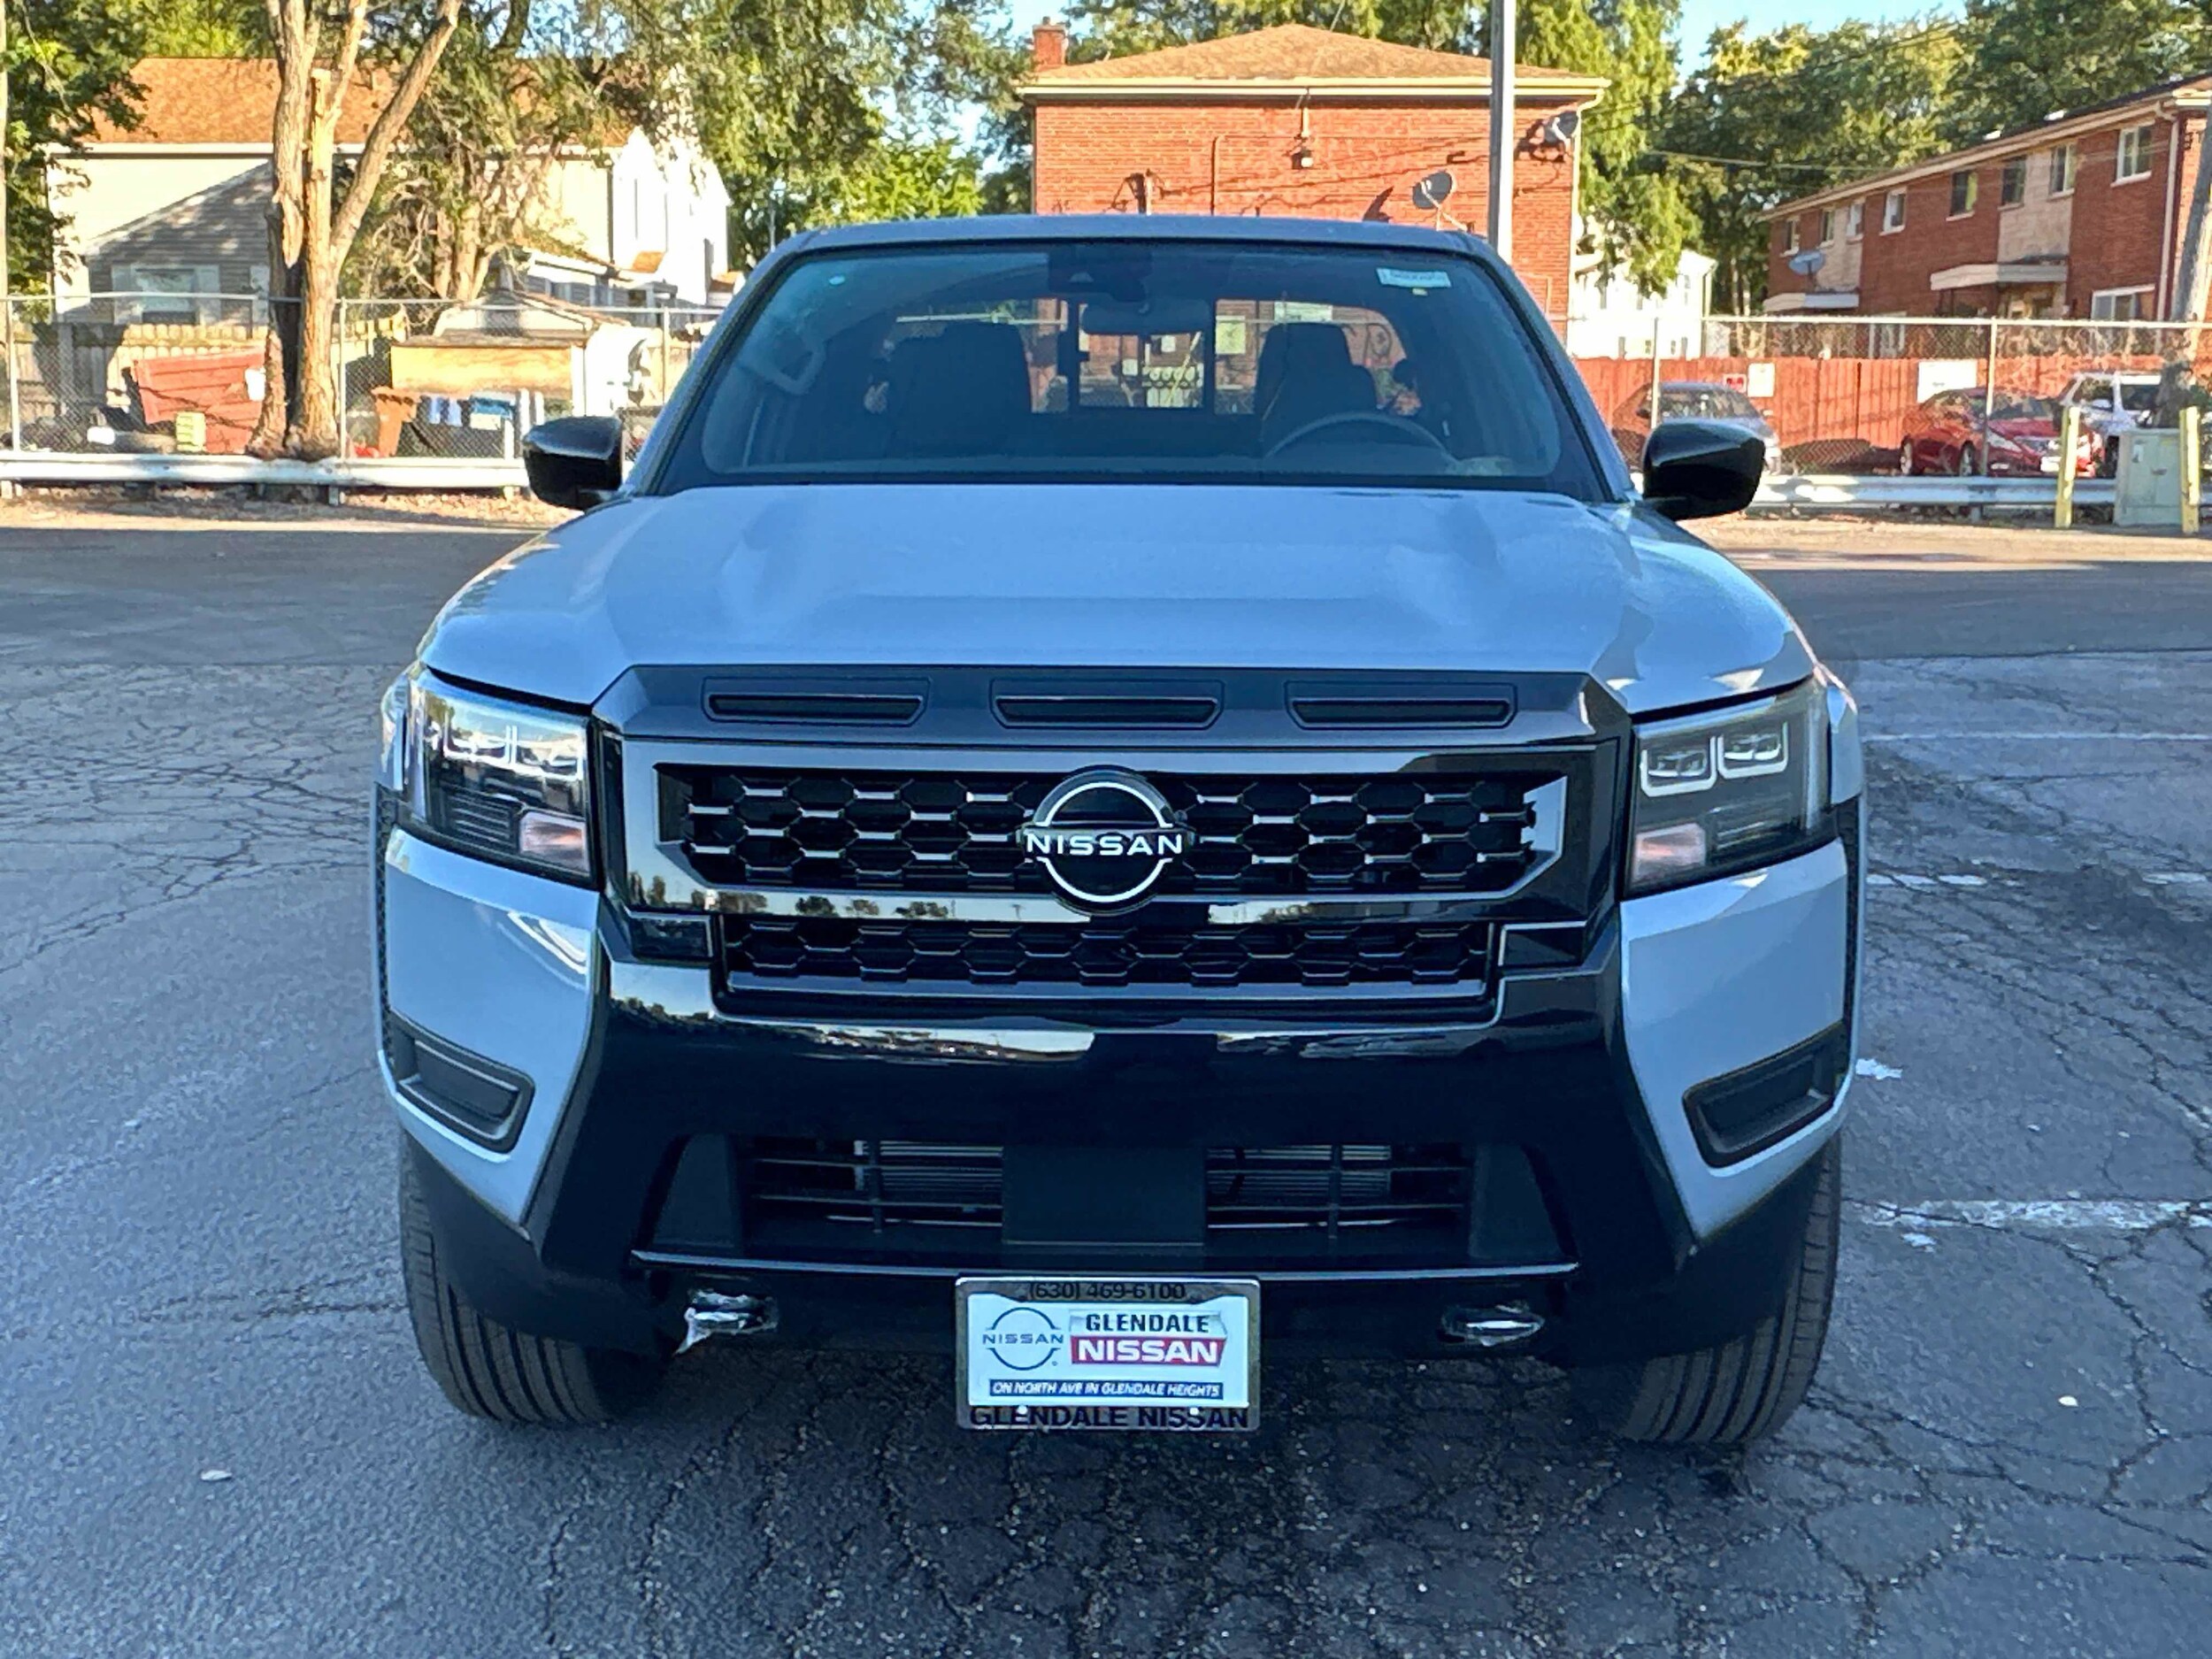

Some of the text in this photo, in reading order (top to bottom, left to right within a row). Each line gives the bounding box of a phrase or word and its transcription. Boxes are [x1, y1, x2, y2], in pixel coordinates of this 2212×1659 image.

[1025, 833, 1183, 856] NISSAN
[1029, 1283, 1187, 1301] (630) 469-6100
[1085, 1314, 1210, 1333] GLENDALE
[982, 1333, 1064, 1345] NISSAN
[1077, 1339, 1218, 1363] NISSAN
[992, 1381, 1220, 1398] ON NORTH AVE IN GLENDALE HEIGHTS
[970, 1405, 1249, 1428] GLENDALE NISSAN
